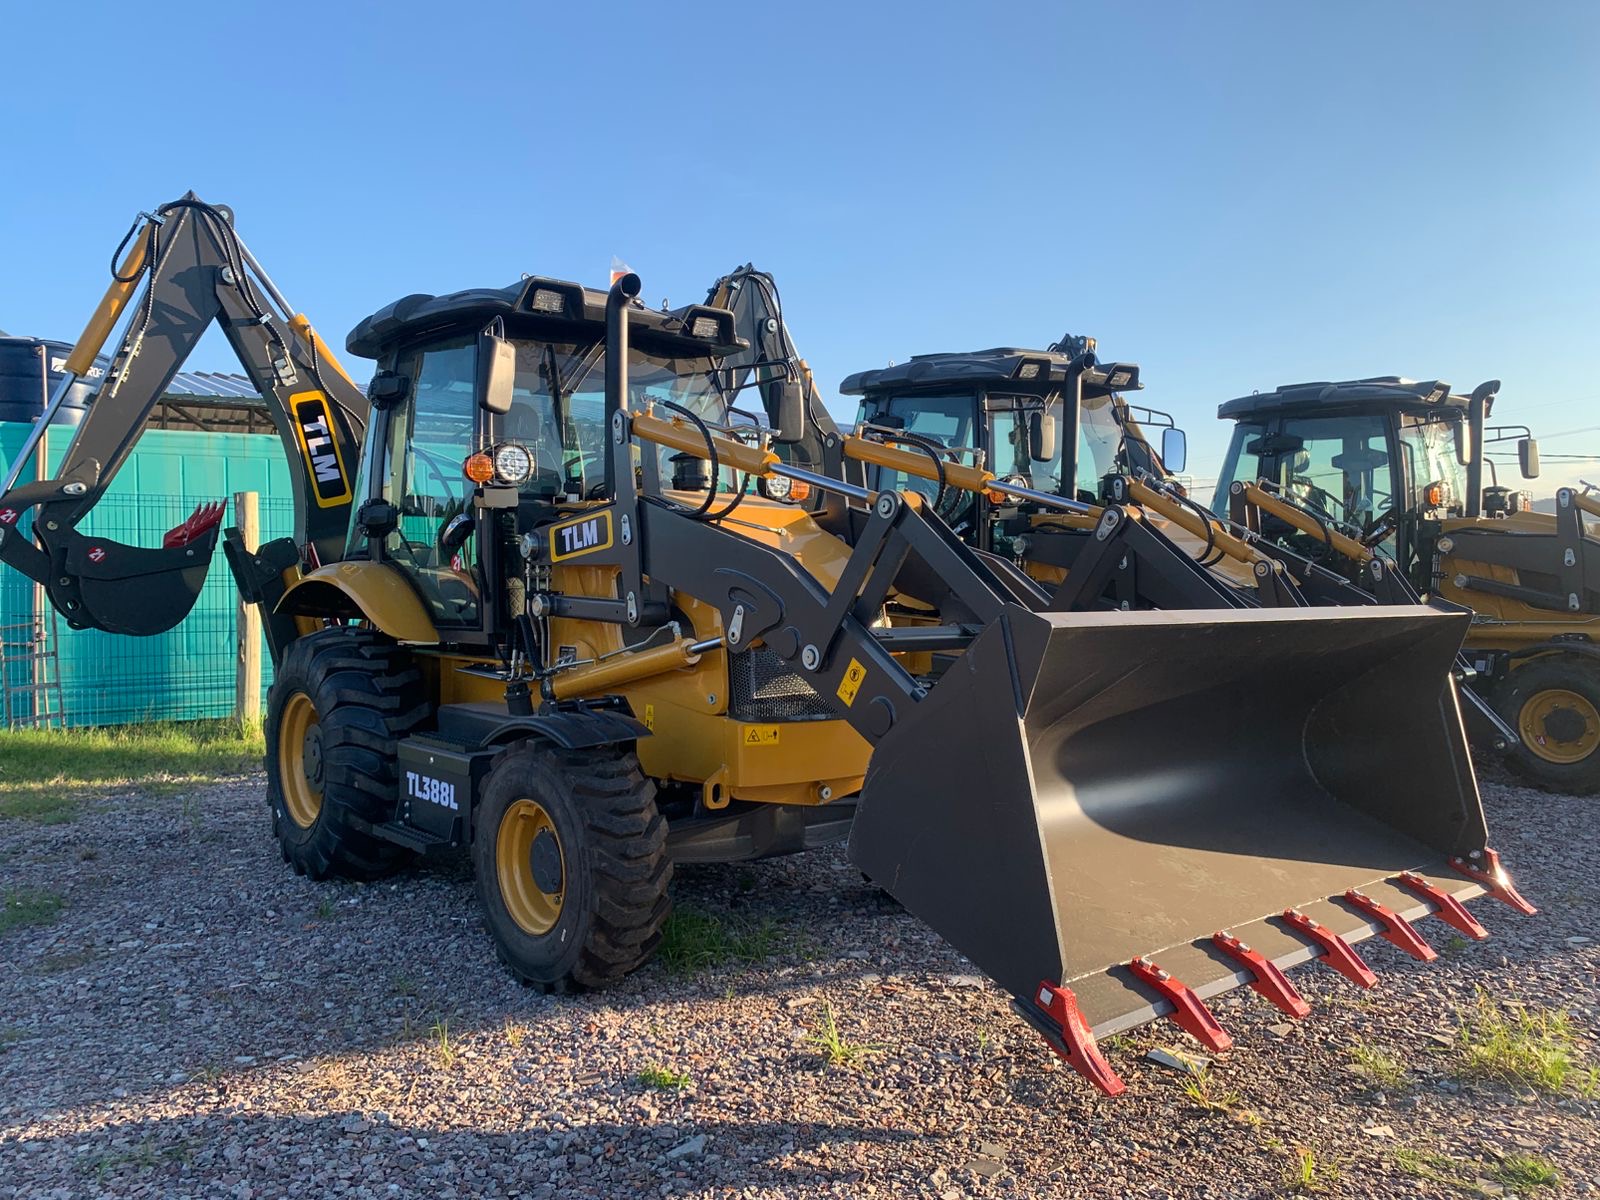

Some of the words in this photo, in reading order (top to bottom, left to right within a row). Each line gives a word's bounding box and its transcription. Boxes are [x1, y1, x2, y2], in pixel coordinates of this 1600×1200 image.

[303, 415, 340, 483] TLM
[0, 509, 17, 523] 21
[561, 519, 598, 552] TLM
[88, 548, 105, 562] 21
[406, 770, 458, 810] TL388L
